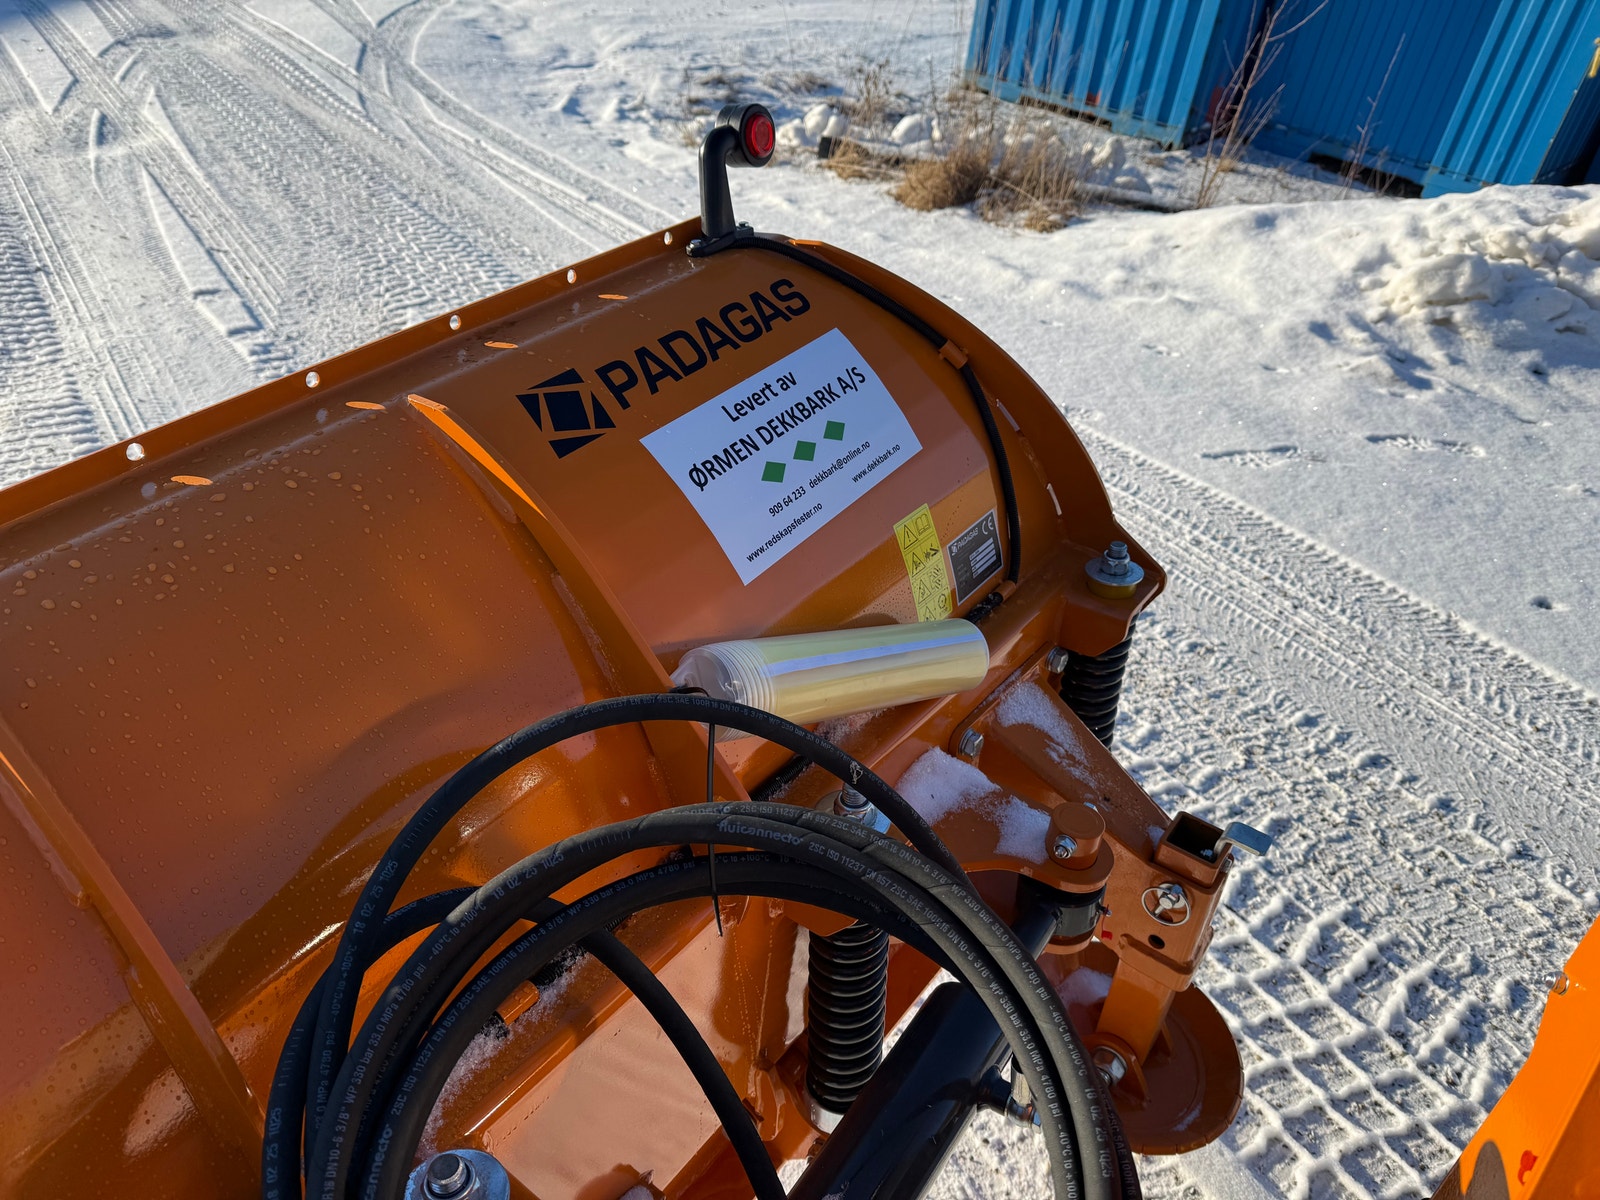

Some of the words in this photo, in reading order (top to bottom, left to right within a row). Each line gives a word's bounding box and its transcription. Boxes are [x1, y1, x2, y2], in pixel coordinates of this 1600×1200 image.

[594, 278, 811, 410] PADAGAS
[721, 382, 779, 422] Levert
[776, 372, 797, 391] av
[688, 434, 760, 491] ØRMEN
[755, 383, 841, 445] DEKKBARK
[836, 366, 866, 395] A/S
[768, 502, 784, 517] 909
[782, 495, 793, 507] 64
[791, 486, 806, 501] 233
[808, 441, 871, 489] dekkbark@online.no
[851, 444, 901, 483] www.dekkbark.no
[746, 502, 823, 563] www.redskapsfester.no
[360, 902, 375, 918] 02
[370, 884, 383, 900] 25
[851, 824, 867, 839] SAE
[951, 884, 966, 897] WP
[964, 895, 980, 912] 330
[979, 909, 993, 925] bar
[1021, 961, 1041, 985] 4780
[390, 1094, 408, 1116] 2SC
[402, 1075, 418, 1093] ISO
[412, 1042, 436, 1073] 11237
[432, 1027, 447, 1043] EN
[442, 1009, 460, 1029] 857
[456, 991, 475, 1012] 2SC
[472, 975, 490, 993] SAE
[567, 902, 582, 917] WP
[583, 894, 599, 909] 330
[600, 888, 614, 899] bar
[635, 871, 655, 884] MPa
[657, 863, 680, 877] 4780
[717, 819, 802, 846] fluiconnecto
[808, 841, 825, 855] 2SC
[826, 849, 839, 862] ISO
[841, 852, 865, 873] 11237
[876, 874, 891, 887] 857
[890, 883, 908, 899] 2SC
[906, 895, 924, 911] SAE
[989, 981, 1003, 995] WP
[1000, 995, 1015, 1013] 330
[1010, 1012, 1023, 1028] bar
[1040, 1074, 1057, 1099] 4780
[350, 1064, 367, 1086] 330
[362, 1048, 376, 1065] bar
[344, 1085, 358, 1104] WP
